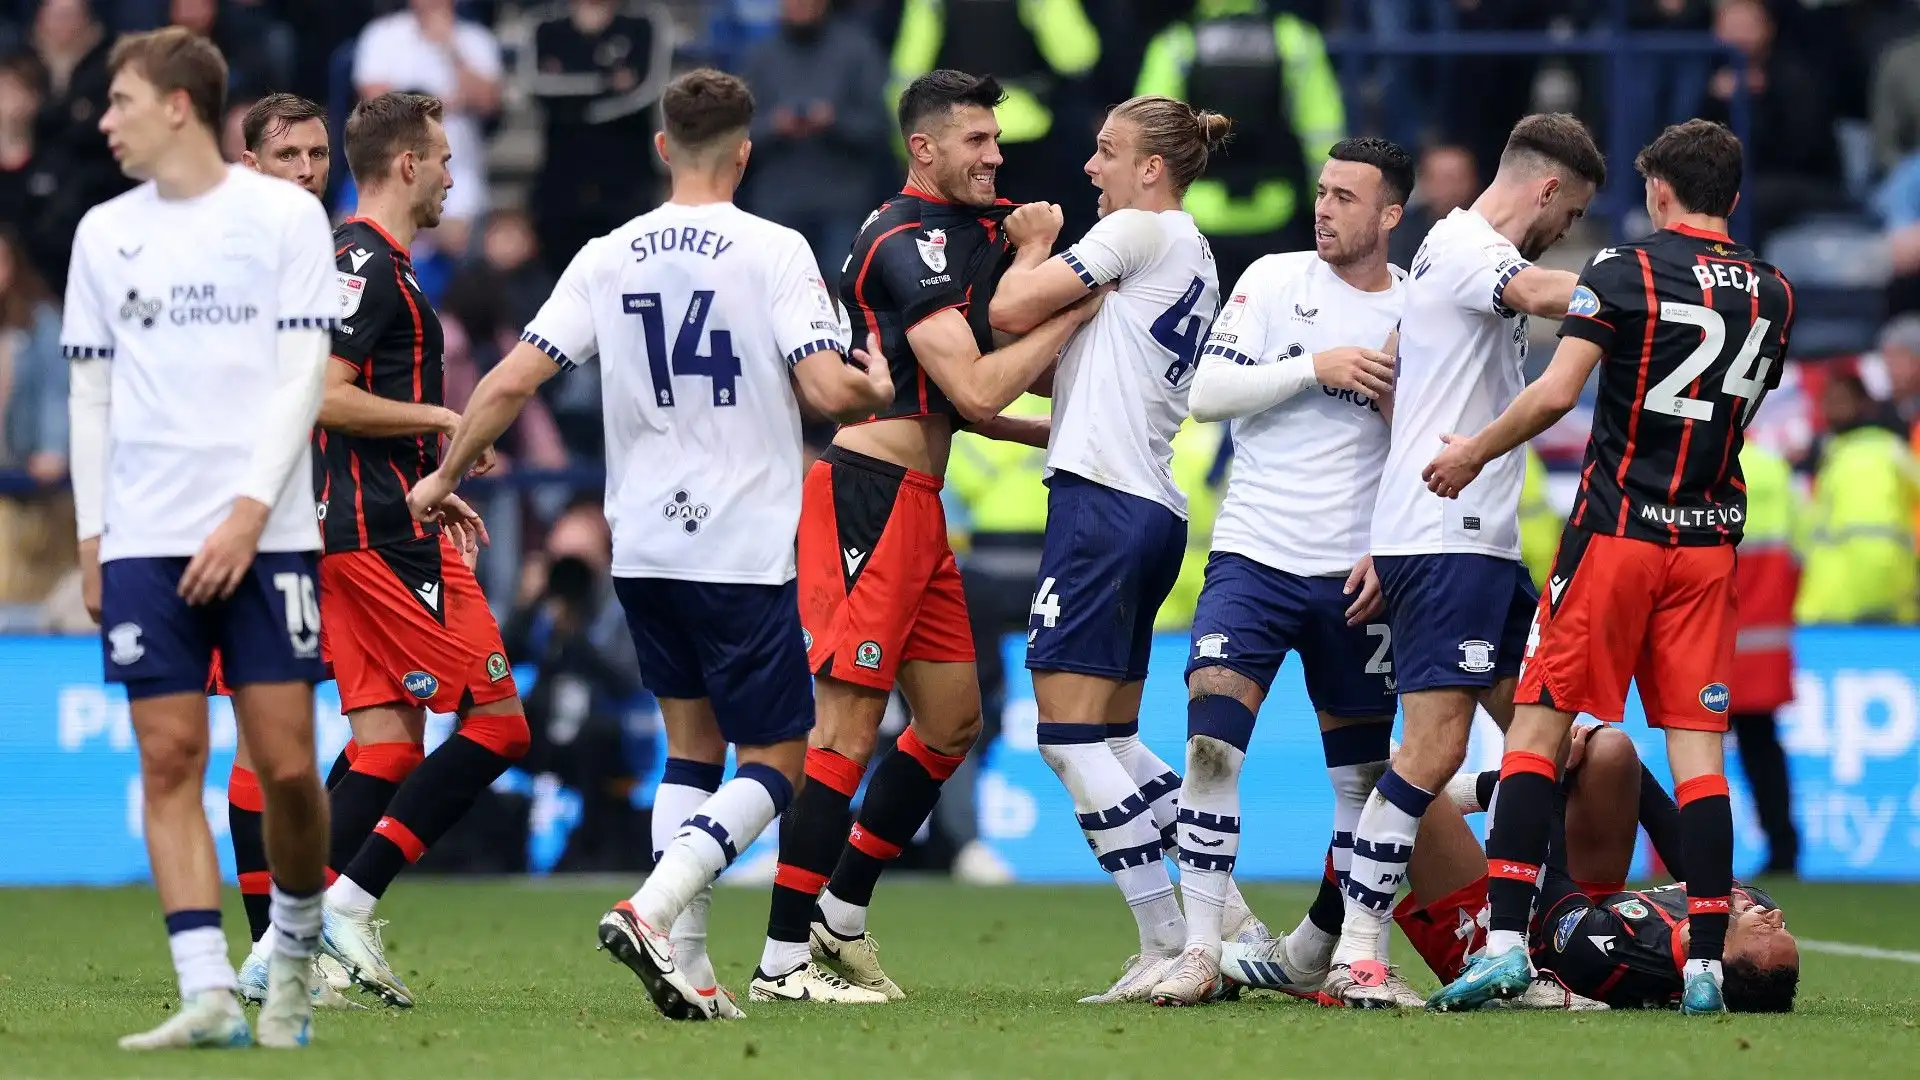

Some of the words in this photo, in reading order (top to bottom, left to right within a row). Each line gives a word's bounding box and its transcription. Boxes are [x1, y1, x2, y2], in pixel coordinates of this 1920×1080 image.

[631, 227, 733, 262] STOREY
[171, 283, 216, 302] PAR
[1692, 264, 1761, 298] BECK
[169, 304, 259, 326] GROUP
[622, 291, 742, 408] 14
[1643, 301, 1774, 427] 24
[667, 503, 708, 518] PAR
[1642, 504, 1742, 527] MULTEVO
[1028, 576, 1061, 628] 4
[405, 676, 436, 692] Venky's
[1704, 690, 1729, 706] Venky's
